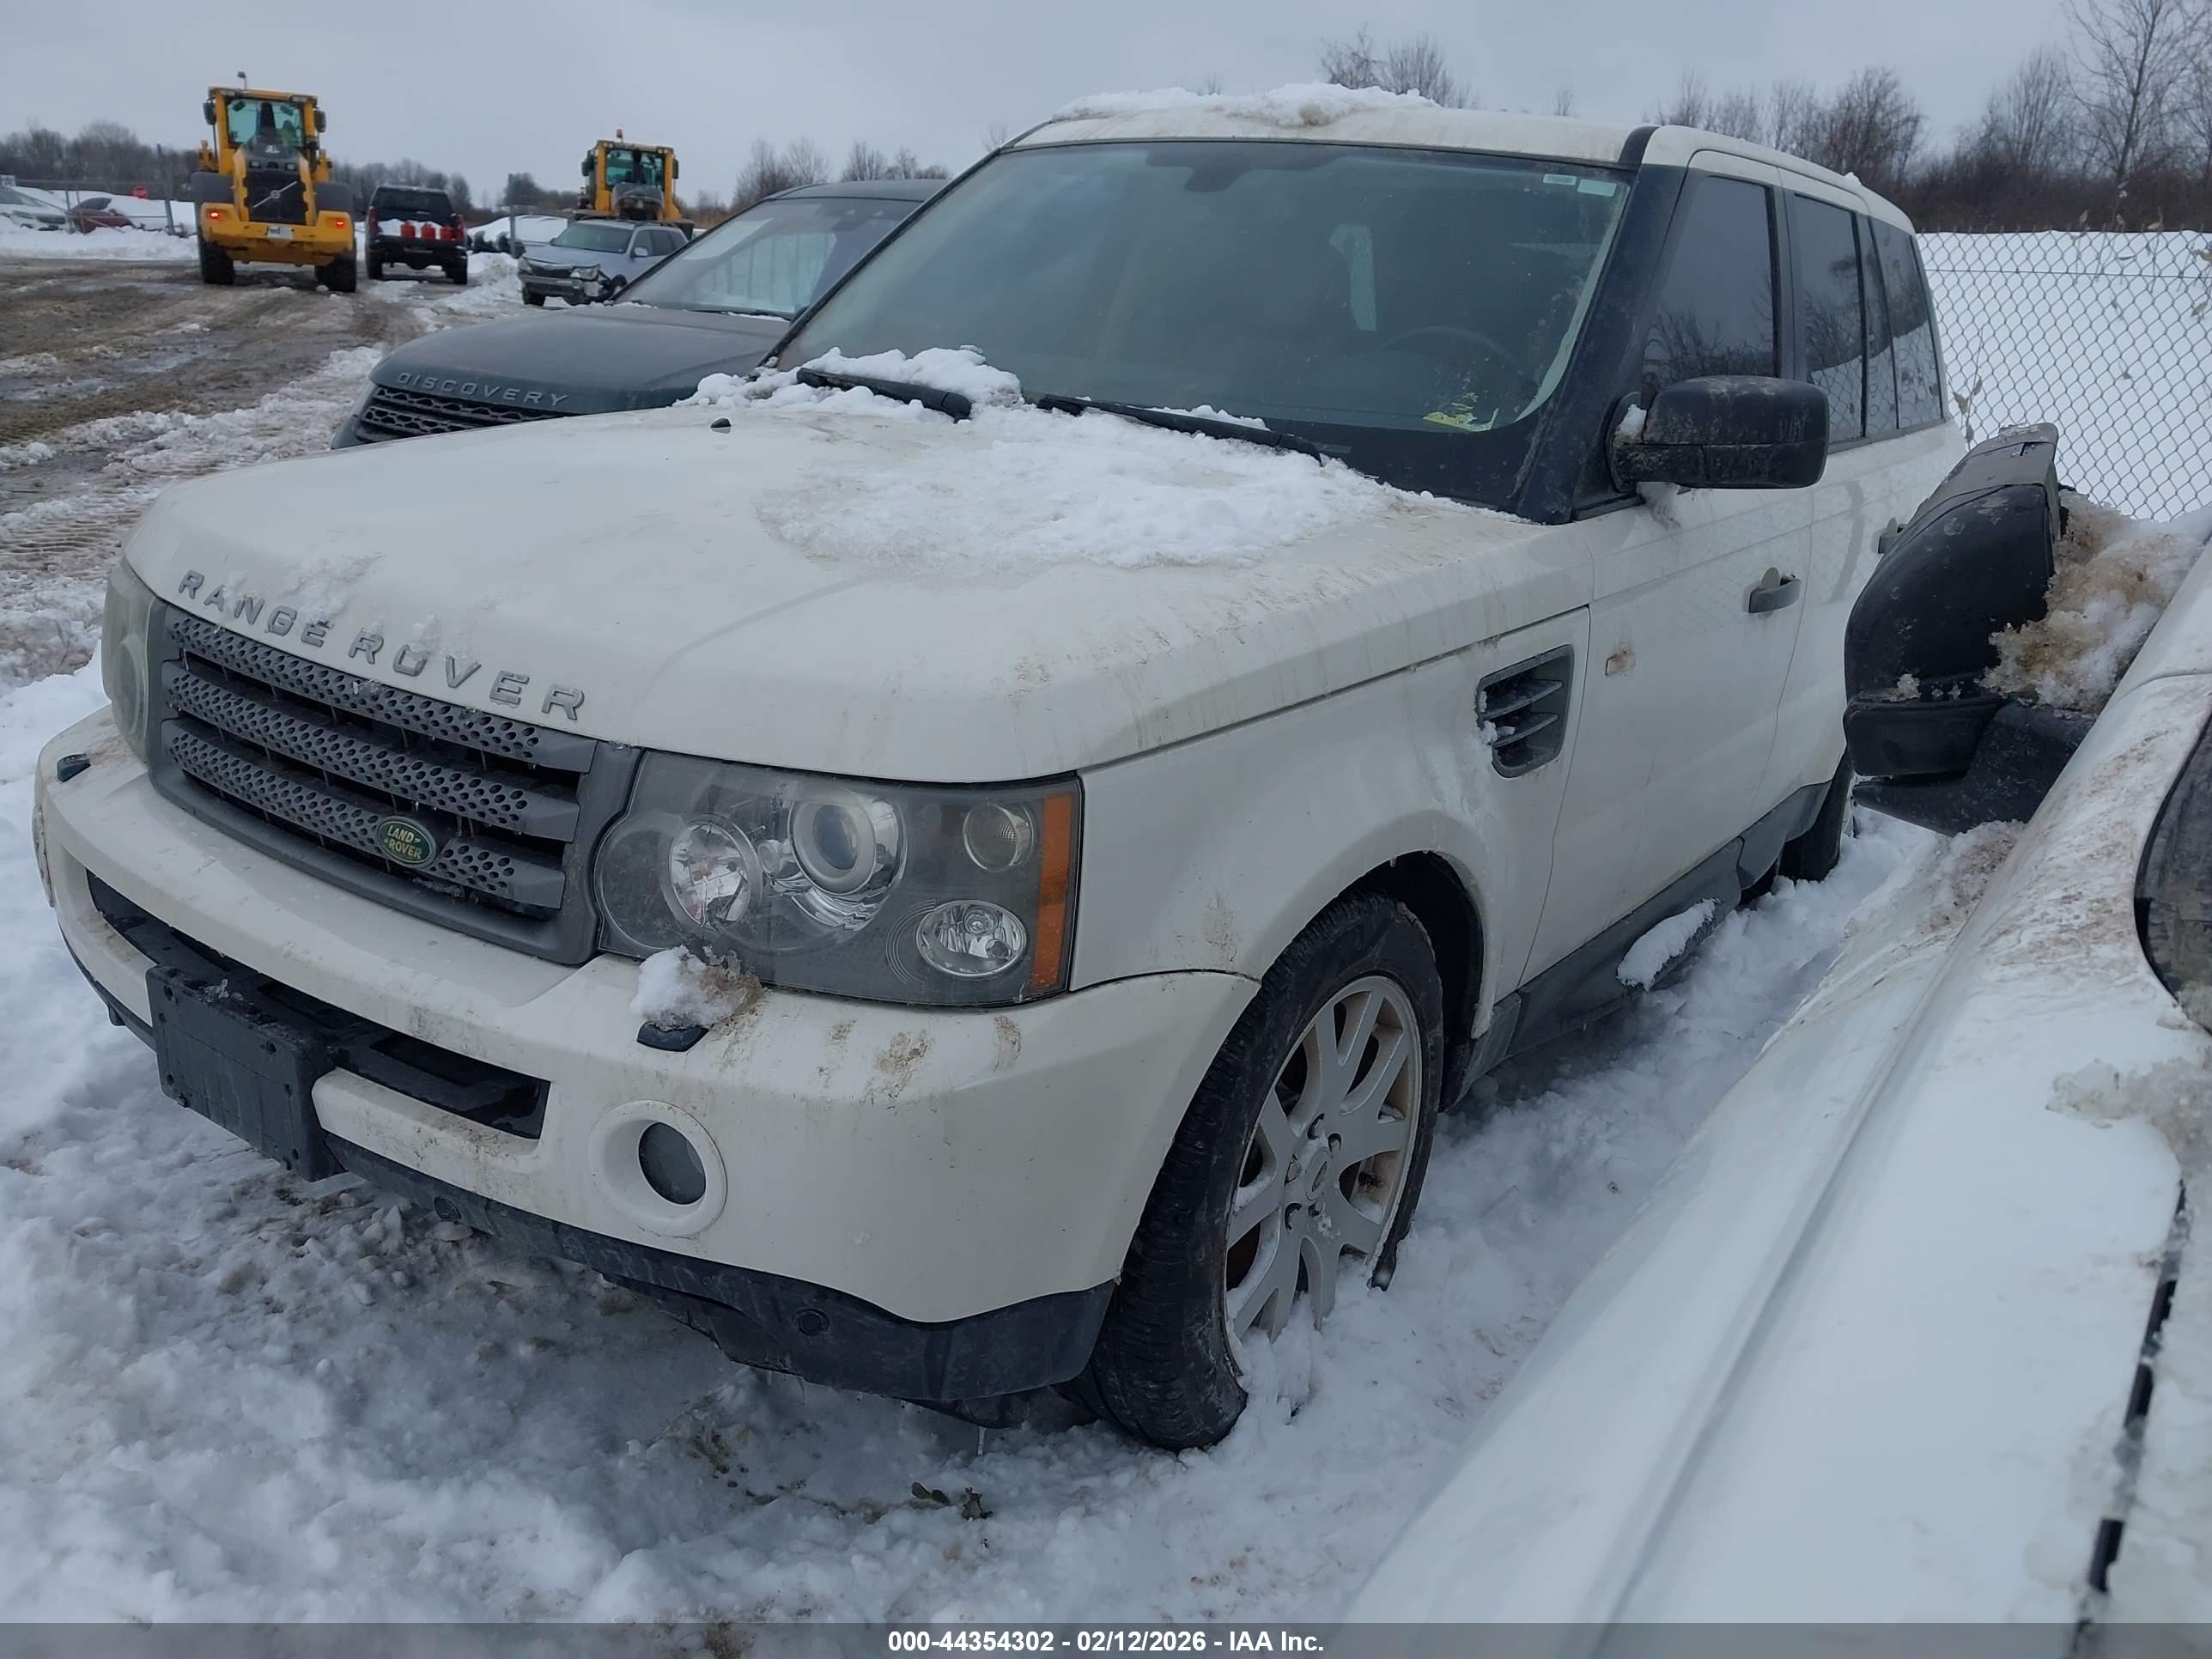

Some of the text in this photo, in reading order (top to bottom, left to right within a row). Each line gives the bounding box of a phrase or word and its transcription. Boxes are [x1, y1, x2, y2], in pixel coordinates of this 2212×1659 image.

[397, 372, 570, 406] DISCOVERY
[178, 569, 586, 721] RANGE ROVER
[387, 838, 422, 860] ROVER
